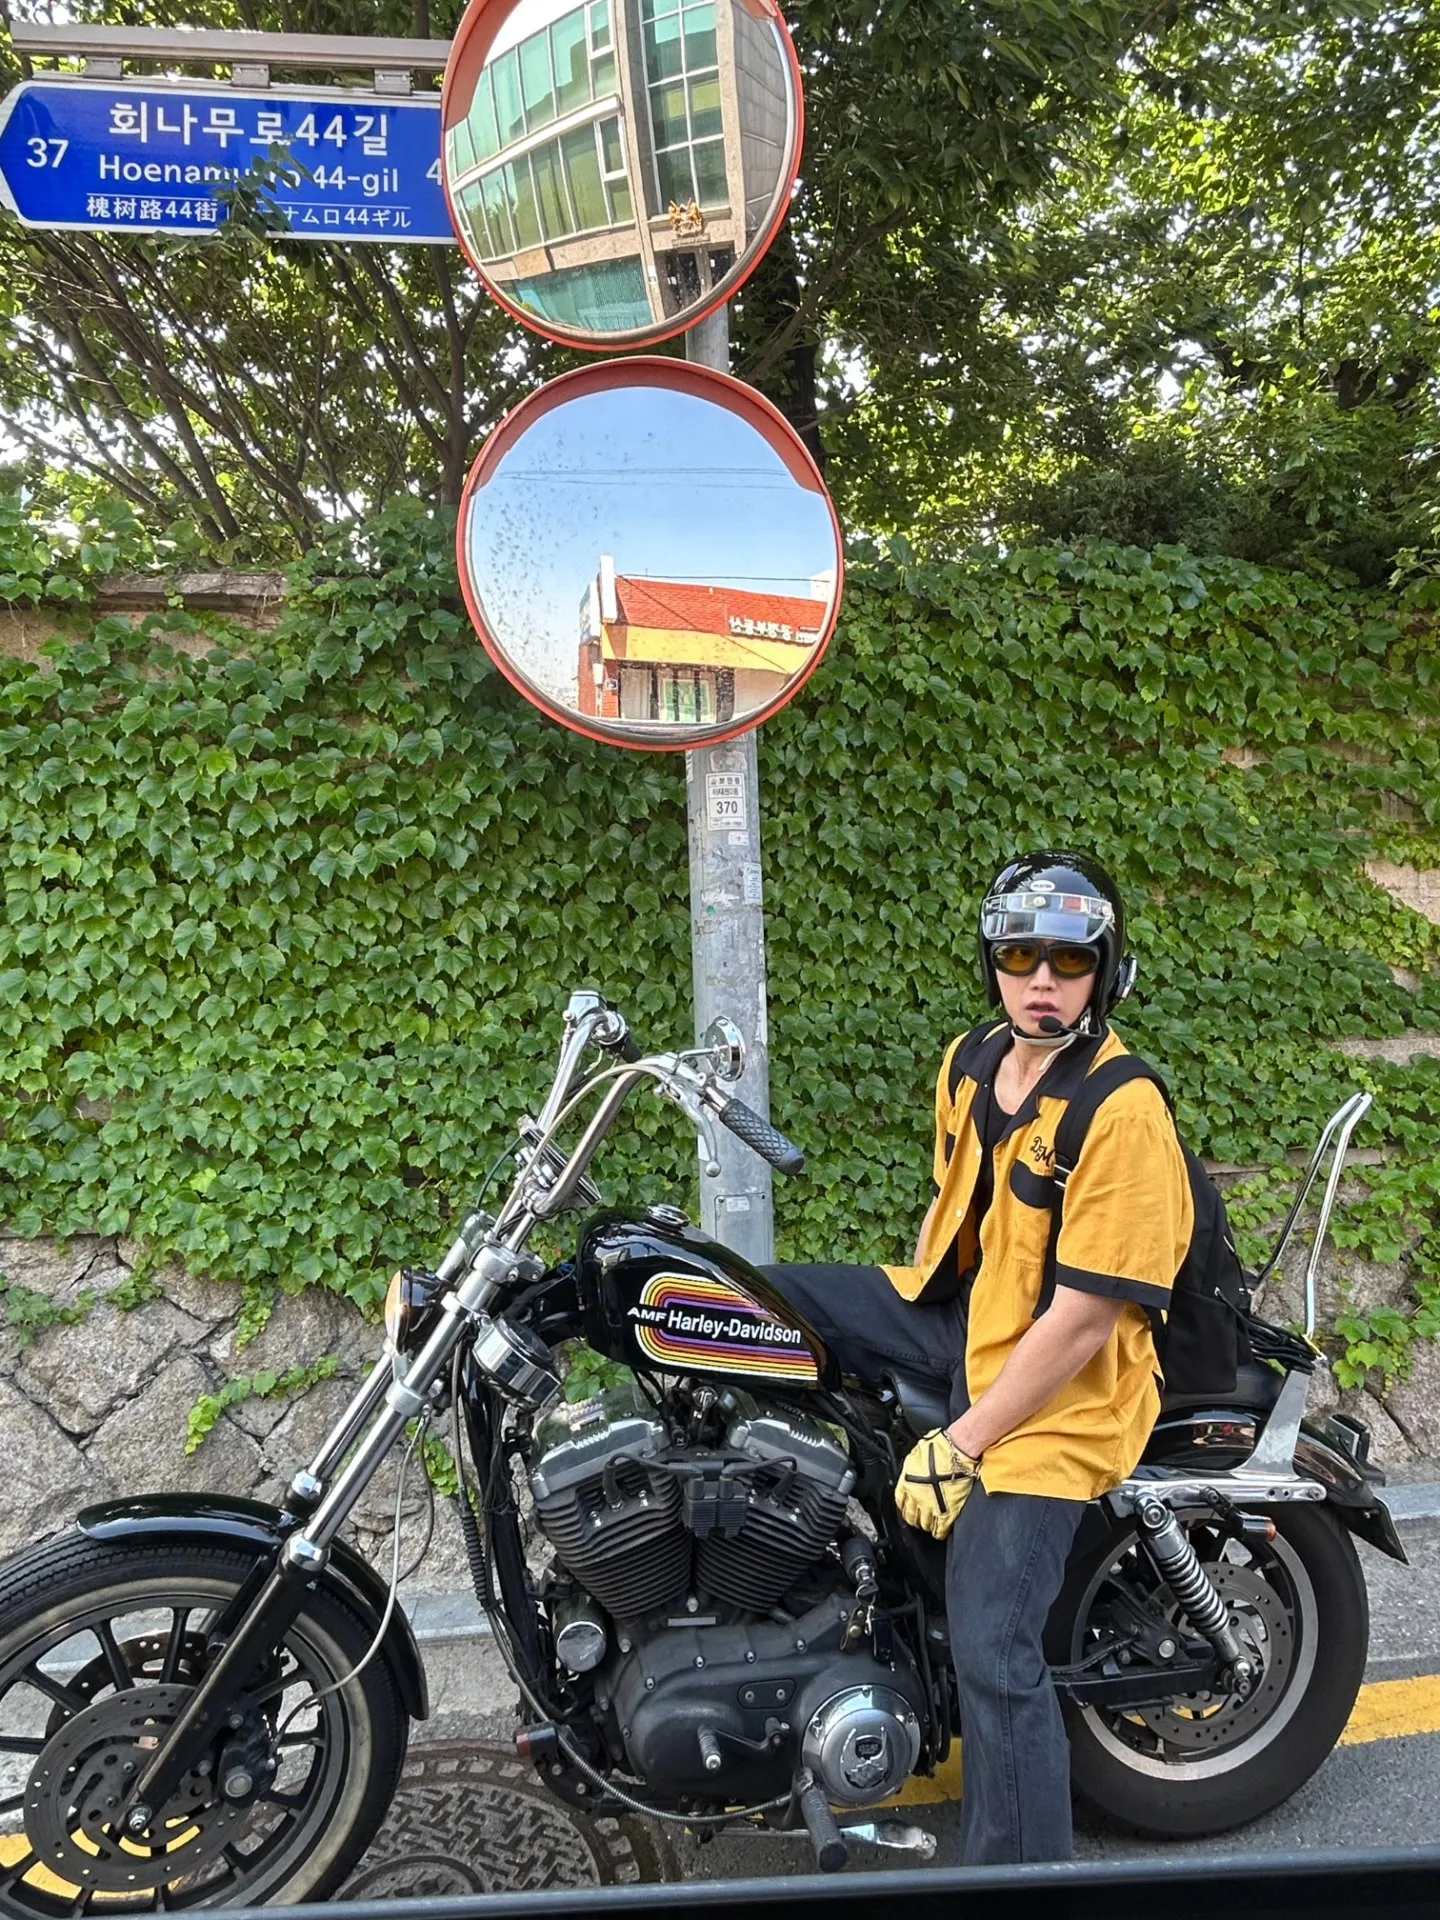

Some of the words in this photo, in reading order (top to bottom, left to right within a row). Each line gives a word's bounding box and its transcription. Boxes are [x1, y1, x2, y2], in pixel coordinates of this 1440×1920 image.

[108, 101, 388, 156] 회나무로44길
[27, 137, 69, 168] 37
[99, 155, 301, 189] Hoenamro
[312, 166, 398, 197] 44-gil
[87, 196, 218, 222] 槐树路44街
[249, 206, 411, 229] ナムロ44ギル
[716, 800, 738, 815] 370
[627, 1306, 667, 1322] AMF
[667, 1310, 801, 1344] Harley-Davidson
